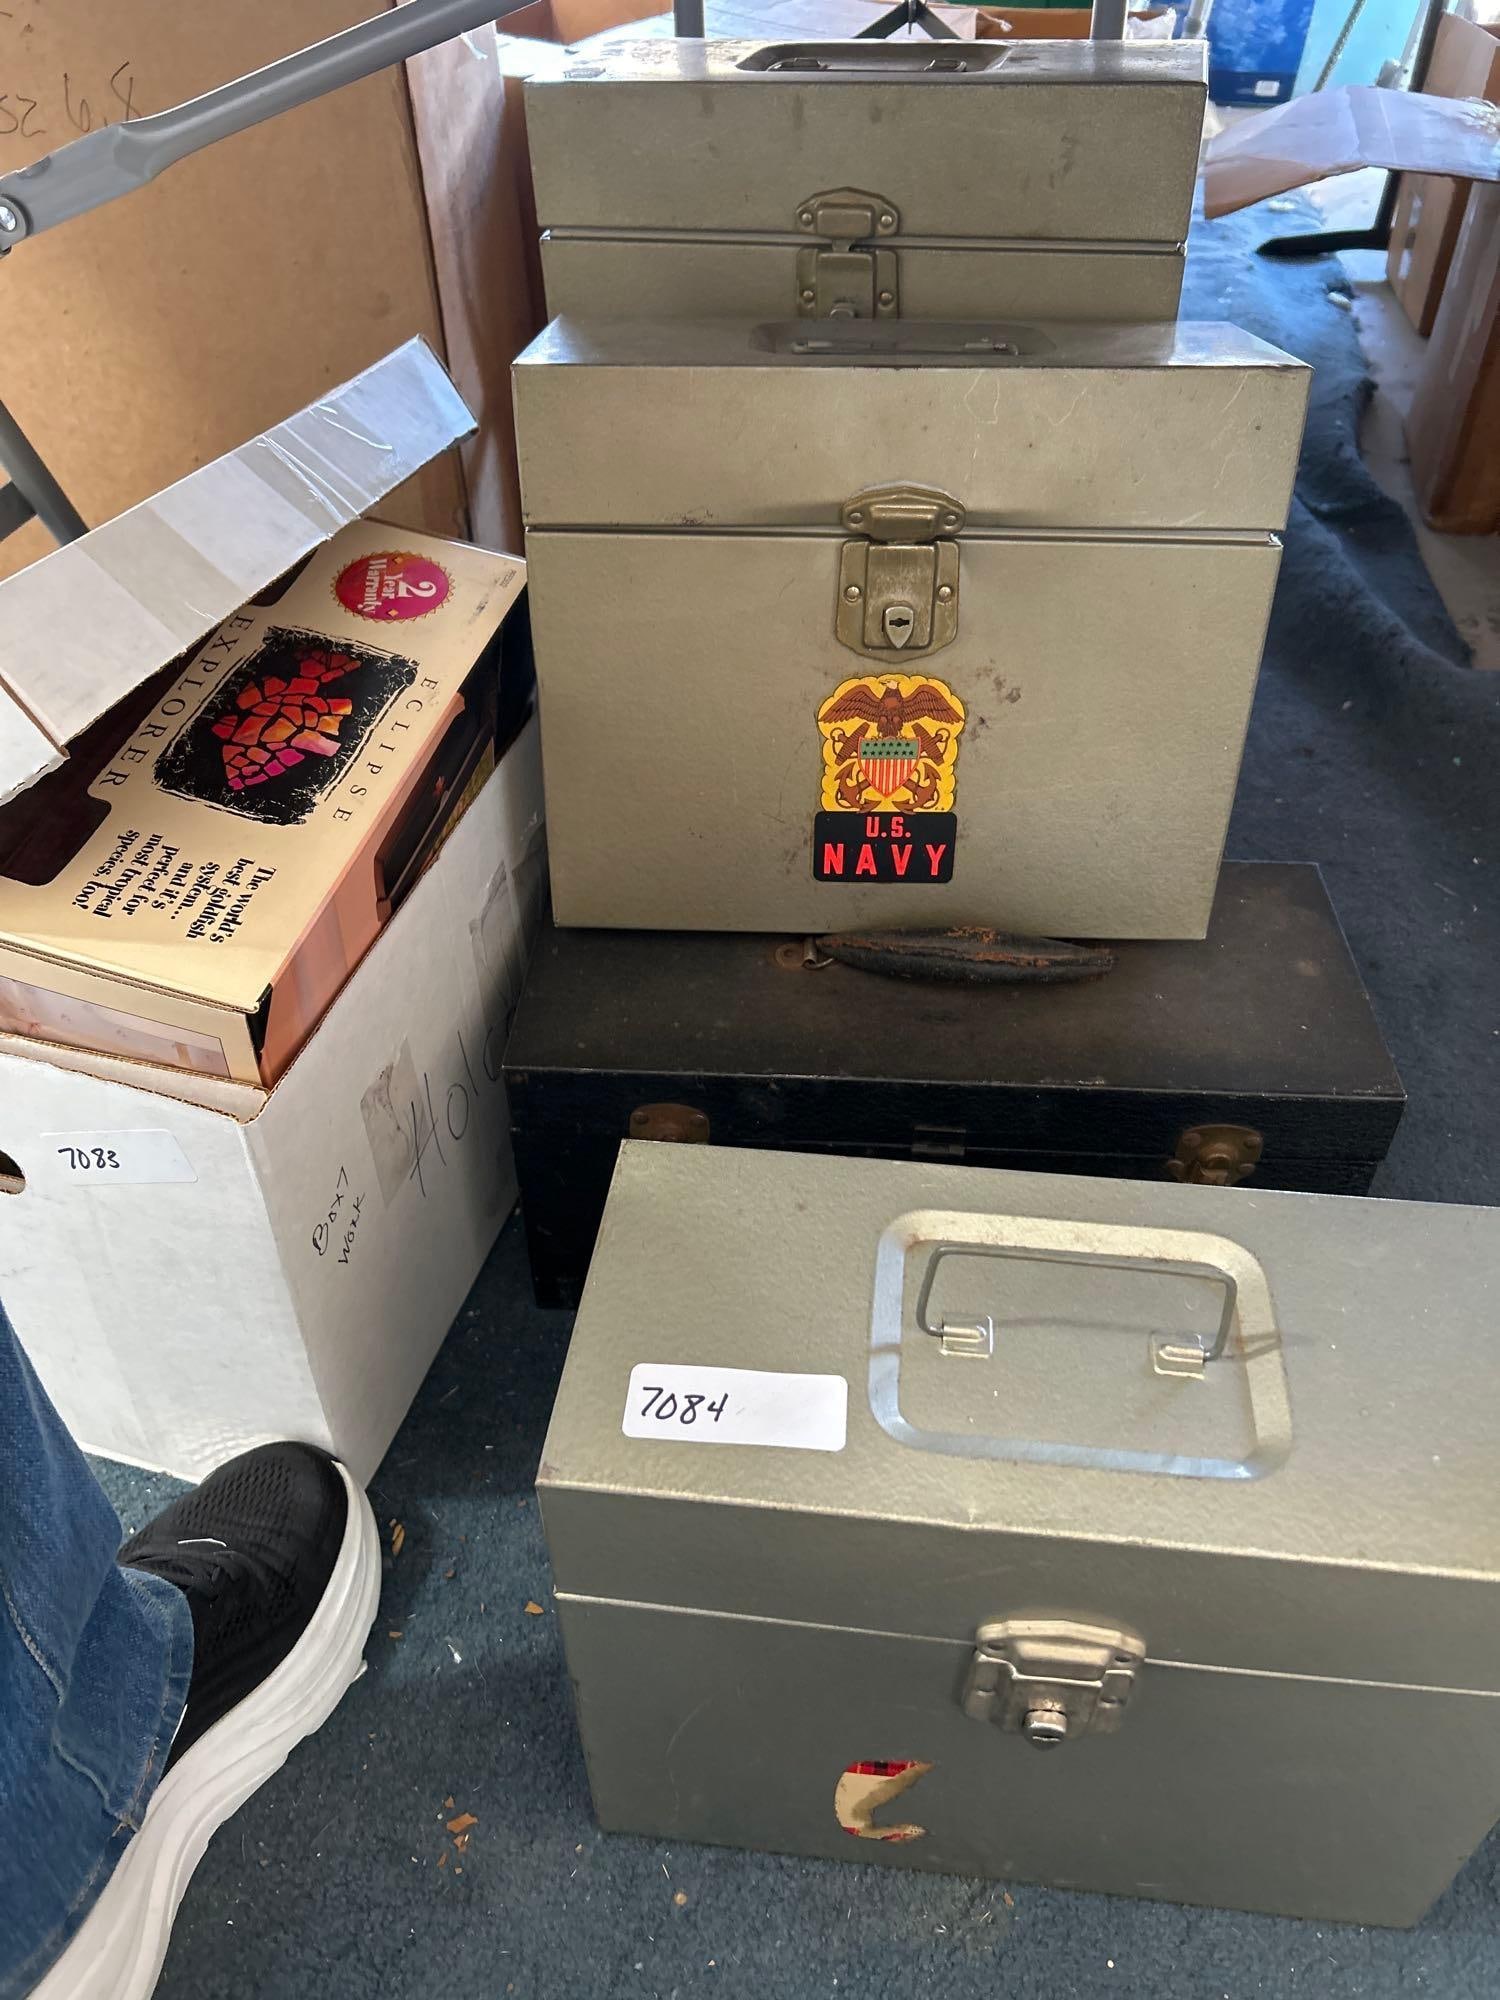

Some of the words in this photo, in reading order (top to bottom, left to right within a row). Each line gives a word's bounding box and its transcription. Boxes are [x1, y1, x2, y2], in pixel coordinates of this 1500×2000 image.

[357, 558, 388, 615] Warranty
[381, 572, 404, 601] Year
[396, 580, 438, 599] 2
[98, 614, 255, 787] EXPLORER
[332, 677, 439, 823] ECLIPSE
[866, 816, 912, 838] U.S.
[92, 829, 141, 877] species,
[130, 833, 164, 867] most
[823, 843, 947, 876] NAVY
[137, 844, 181, 893] perfect
[169, 862, 193, 888] and
[222, 858, 256, 887] best
[246, 867, 277, 891] The
[71, 881, 106, 910] too!
[92, 868, 143, 918] tropical
[121, 894, 150, 916] for
[151, 888, 180, 910] it's
[170, 861, 221, 919] system...
[186, 884, 232, 939] goldfish
[209, 893, 254, 943] world's
[57, 1147, 120, 1170] 7083
[641, 1386, 729, 1425] 7084
